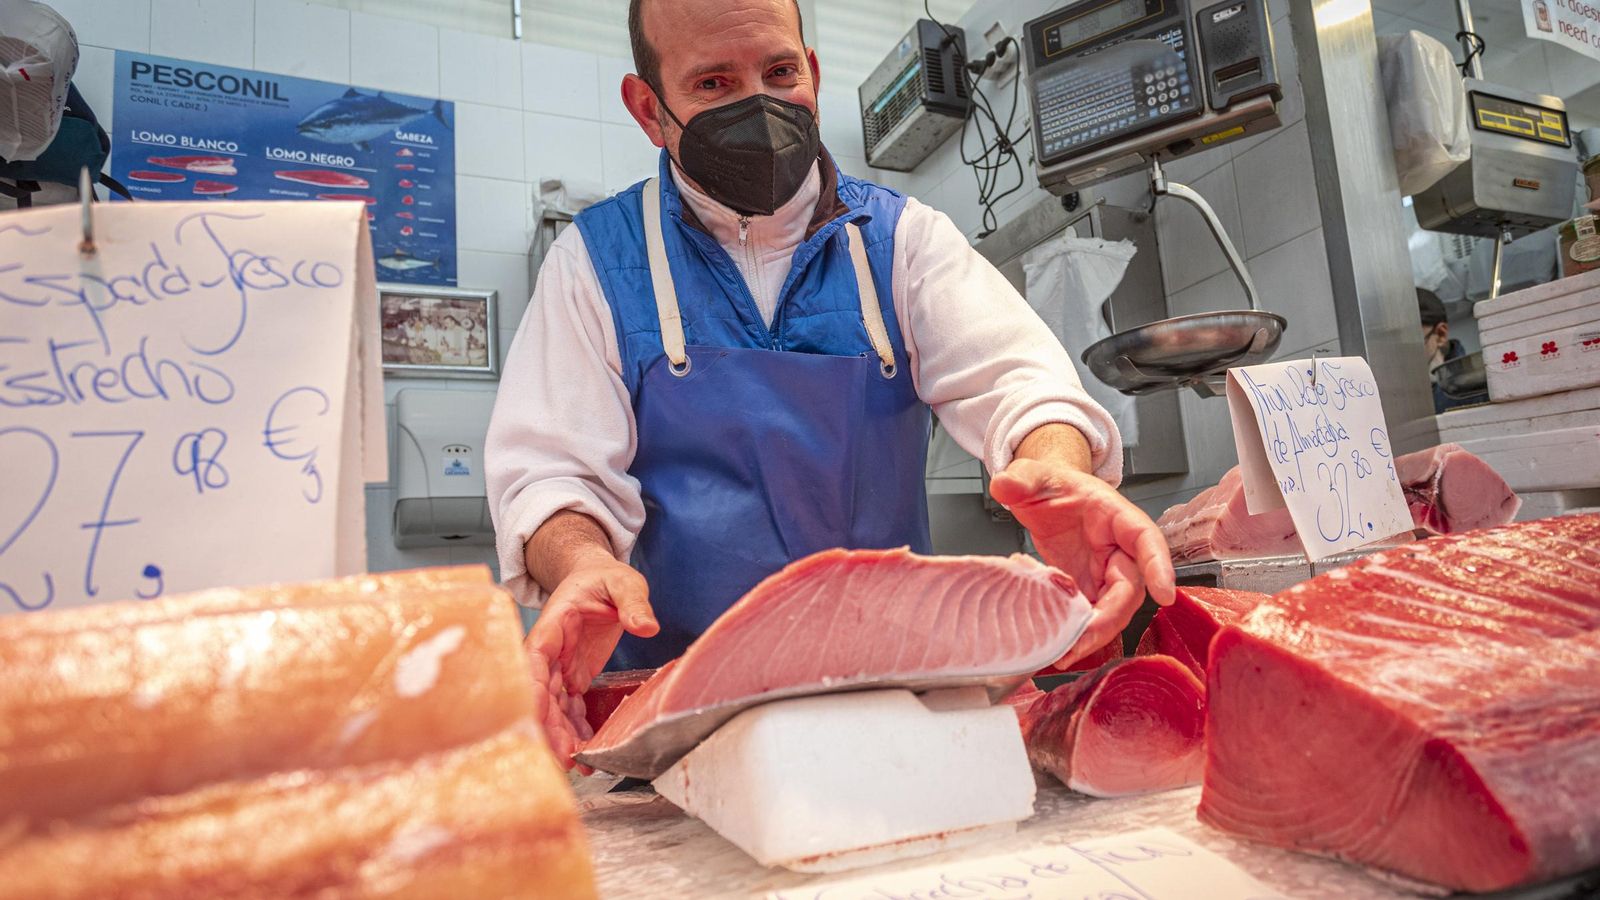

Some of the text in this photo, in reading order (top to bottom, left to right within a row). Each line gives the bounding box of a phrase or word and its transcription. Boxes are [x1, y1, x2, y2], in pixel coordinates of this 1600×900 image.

[1558, 20, 1589, 44] need
[130, 60, 291, 103] PESCONIL
[130, 94, 162, 107] CONIL
[131, 129, 239, 153] LOMO BLANCO
[395, 130, 434, 145] CABEZA
[265, 147, 356, 168] LOMO NEGRO
